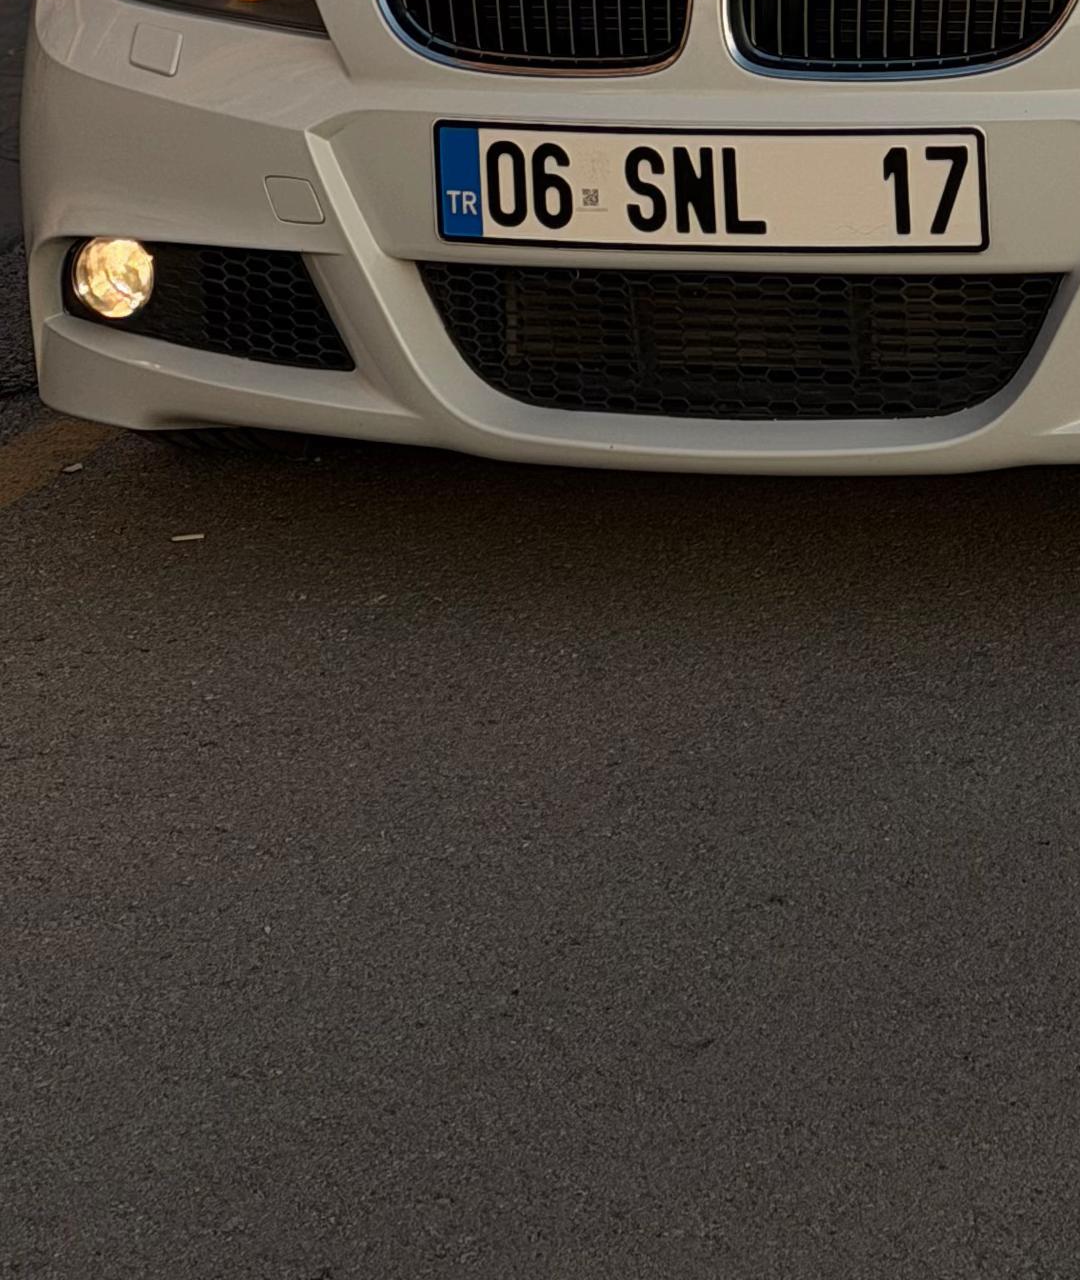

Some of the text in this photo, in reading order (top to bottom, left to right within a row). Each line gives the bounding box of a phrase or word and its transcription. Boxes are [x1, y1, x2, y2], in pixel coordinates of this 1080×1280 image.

[447, 190, 477, 215] TR
[486, 141, 968, 235] 06 SNL 17
